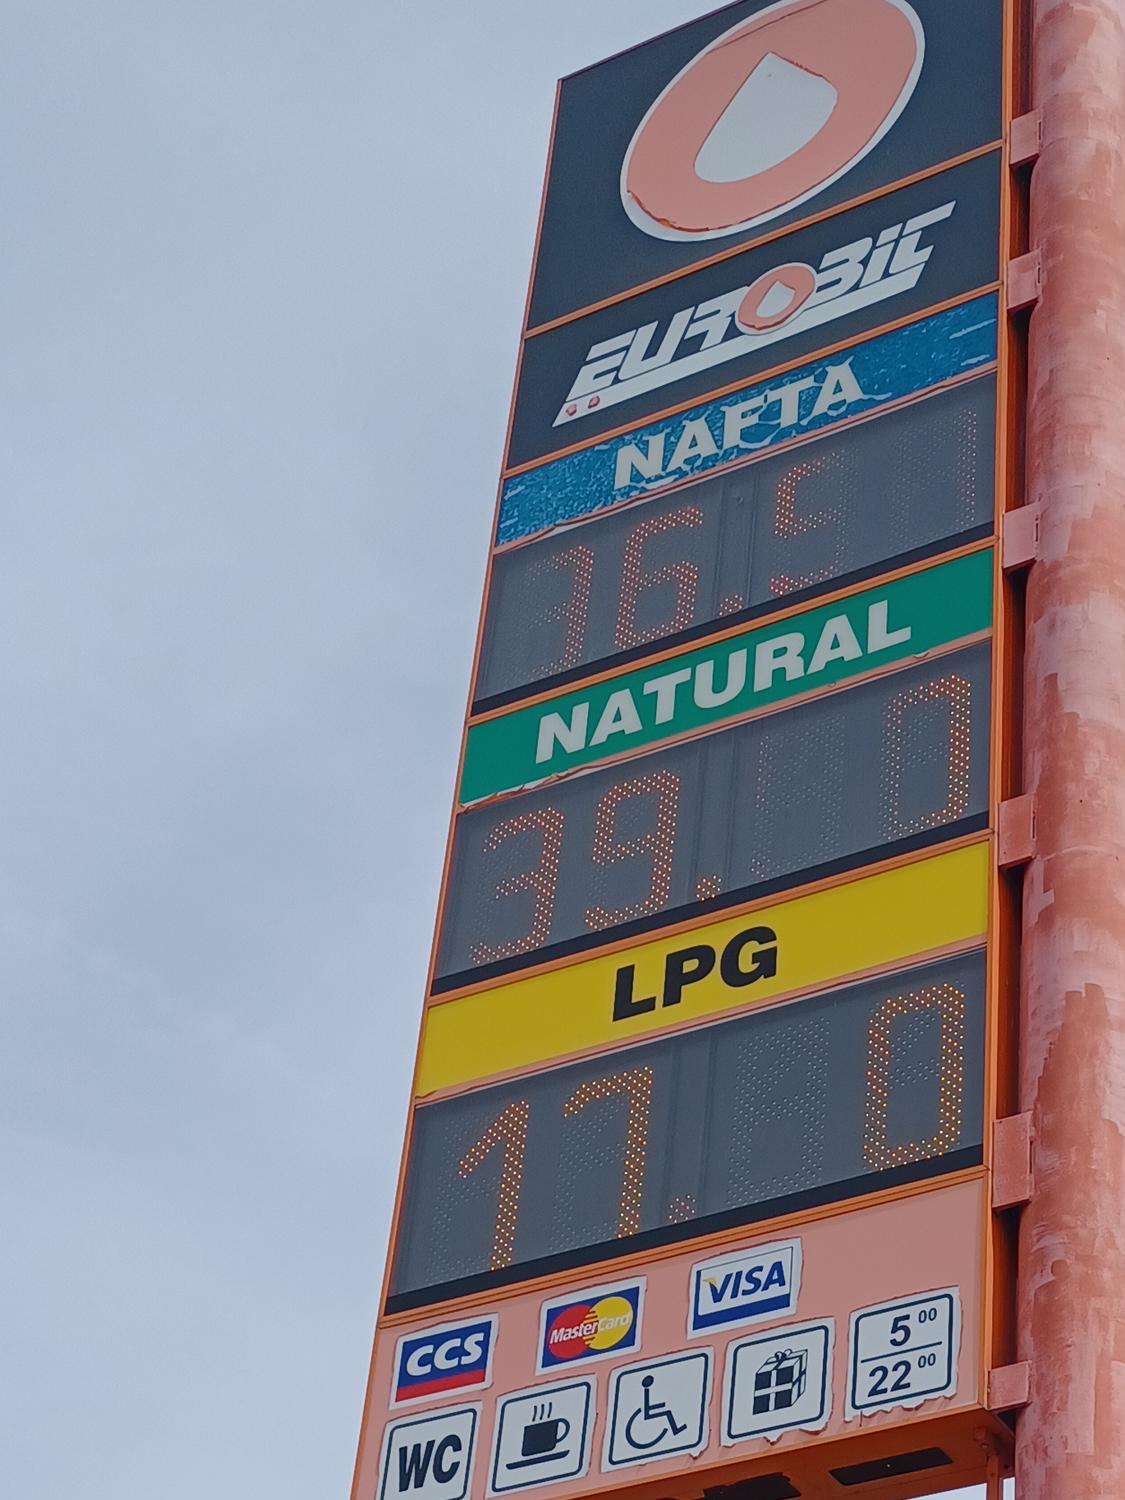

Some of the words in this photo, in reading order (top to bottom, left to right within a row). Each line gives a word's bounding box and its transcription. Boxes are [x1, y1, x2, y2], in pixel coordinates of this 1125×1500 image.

[613, 357, 866, 492] NAFTA
[534, 599, 912, 764] NATURAL
[611, 926, 779, 1022] LPG
[707, 1260, 787, 1304] VISA
[549, 1311, 631, 1345] MasterCard
[406, 1332, 485, 1377] CCS
[866, 1361, 913, 1398] 22
[398, 1434, 463, 1493] WC
